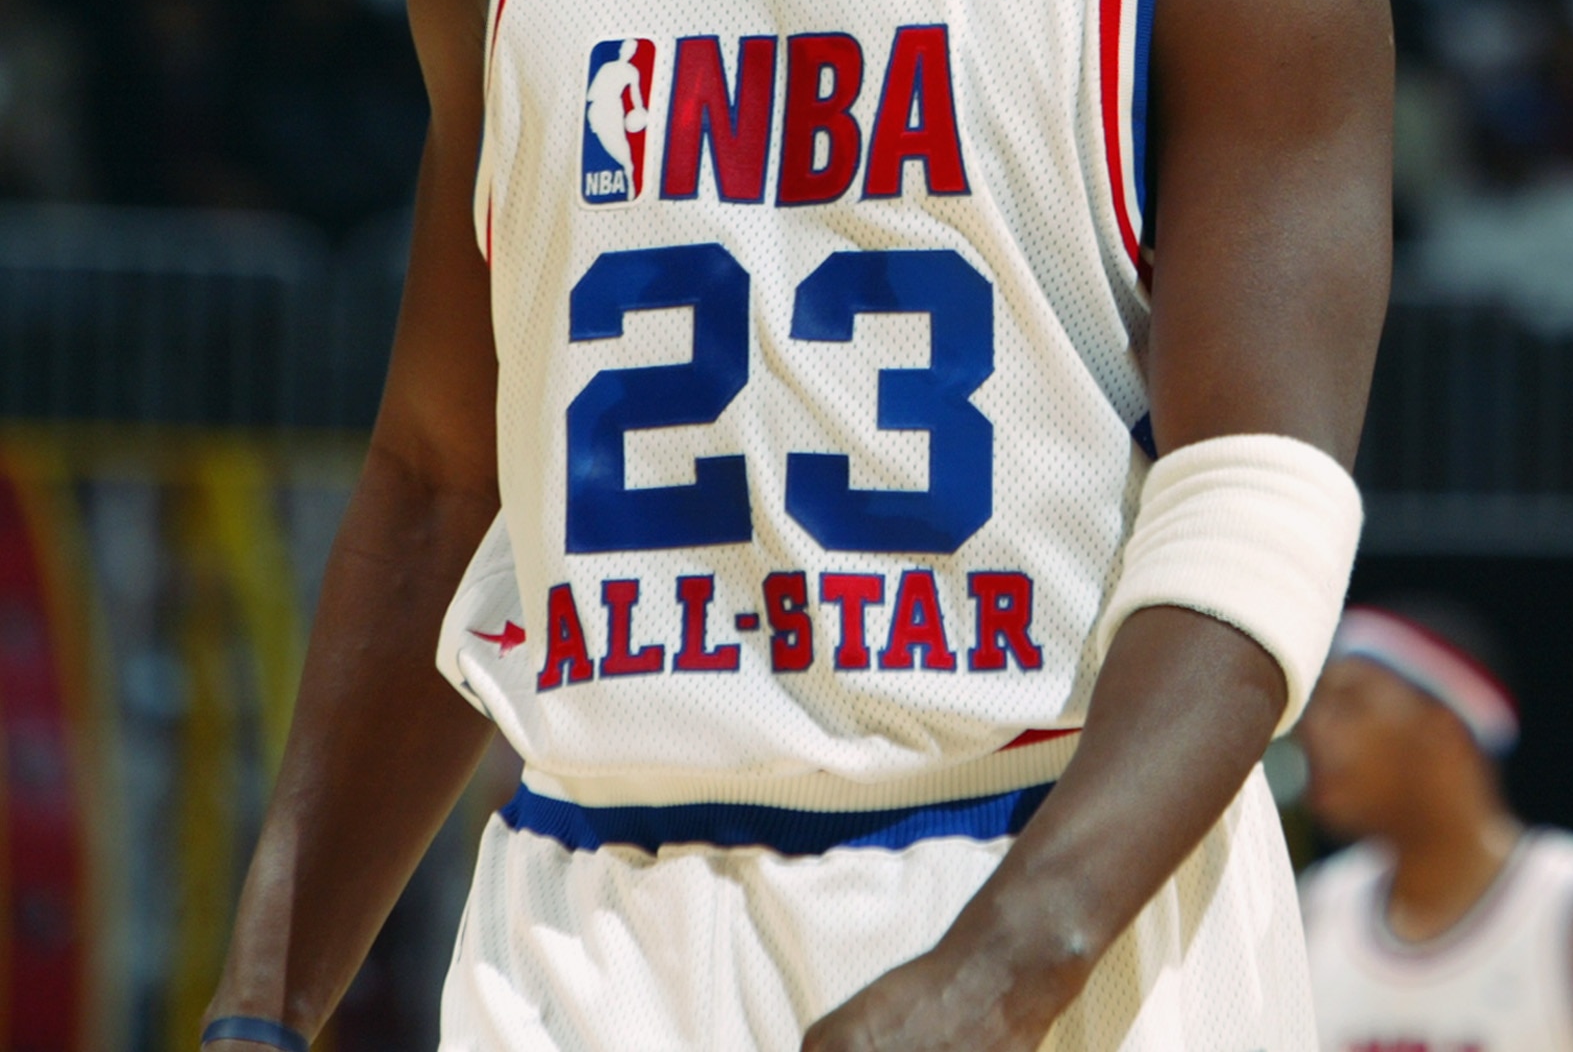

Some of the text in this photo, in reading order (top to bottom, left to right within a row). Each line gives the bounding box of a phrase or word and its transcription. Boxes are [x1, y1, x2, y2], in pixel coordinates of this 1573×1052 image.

[585, 169, 626, 197] NBA
[659, 23, 973, 208] NBA
[565, 242, 996, 554] 23
[536, 567, 1045, 693] ALL-STAR
